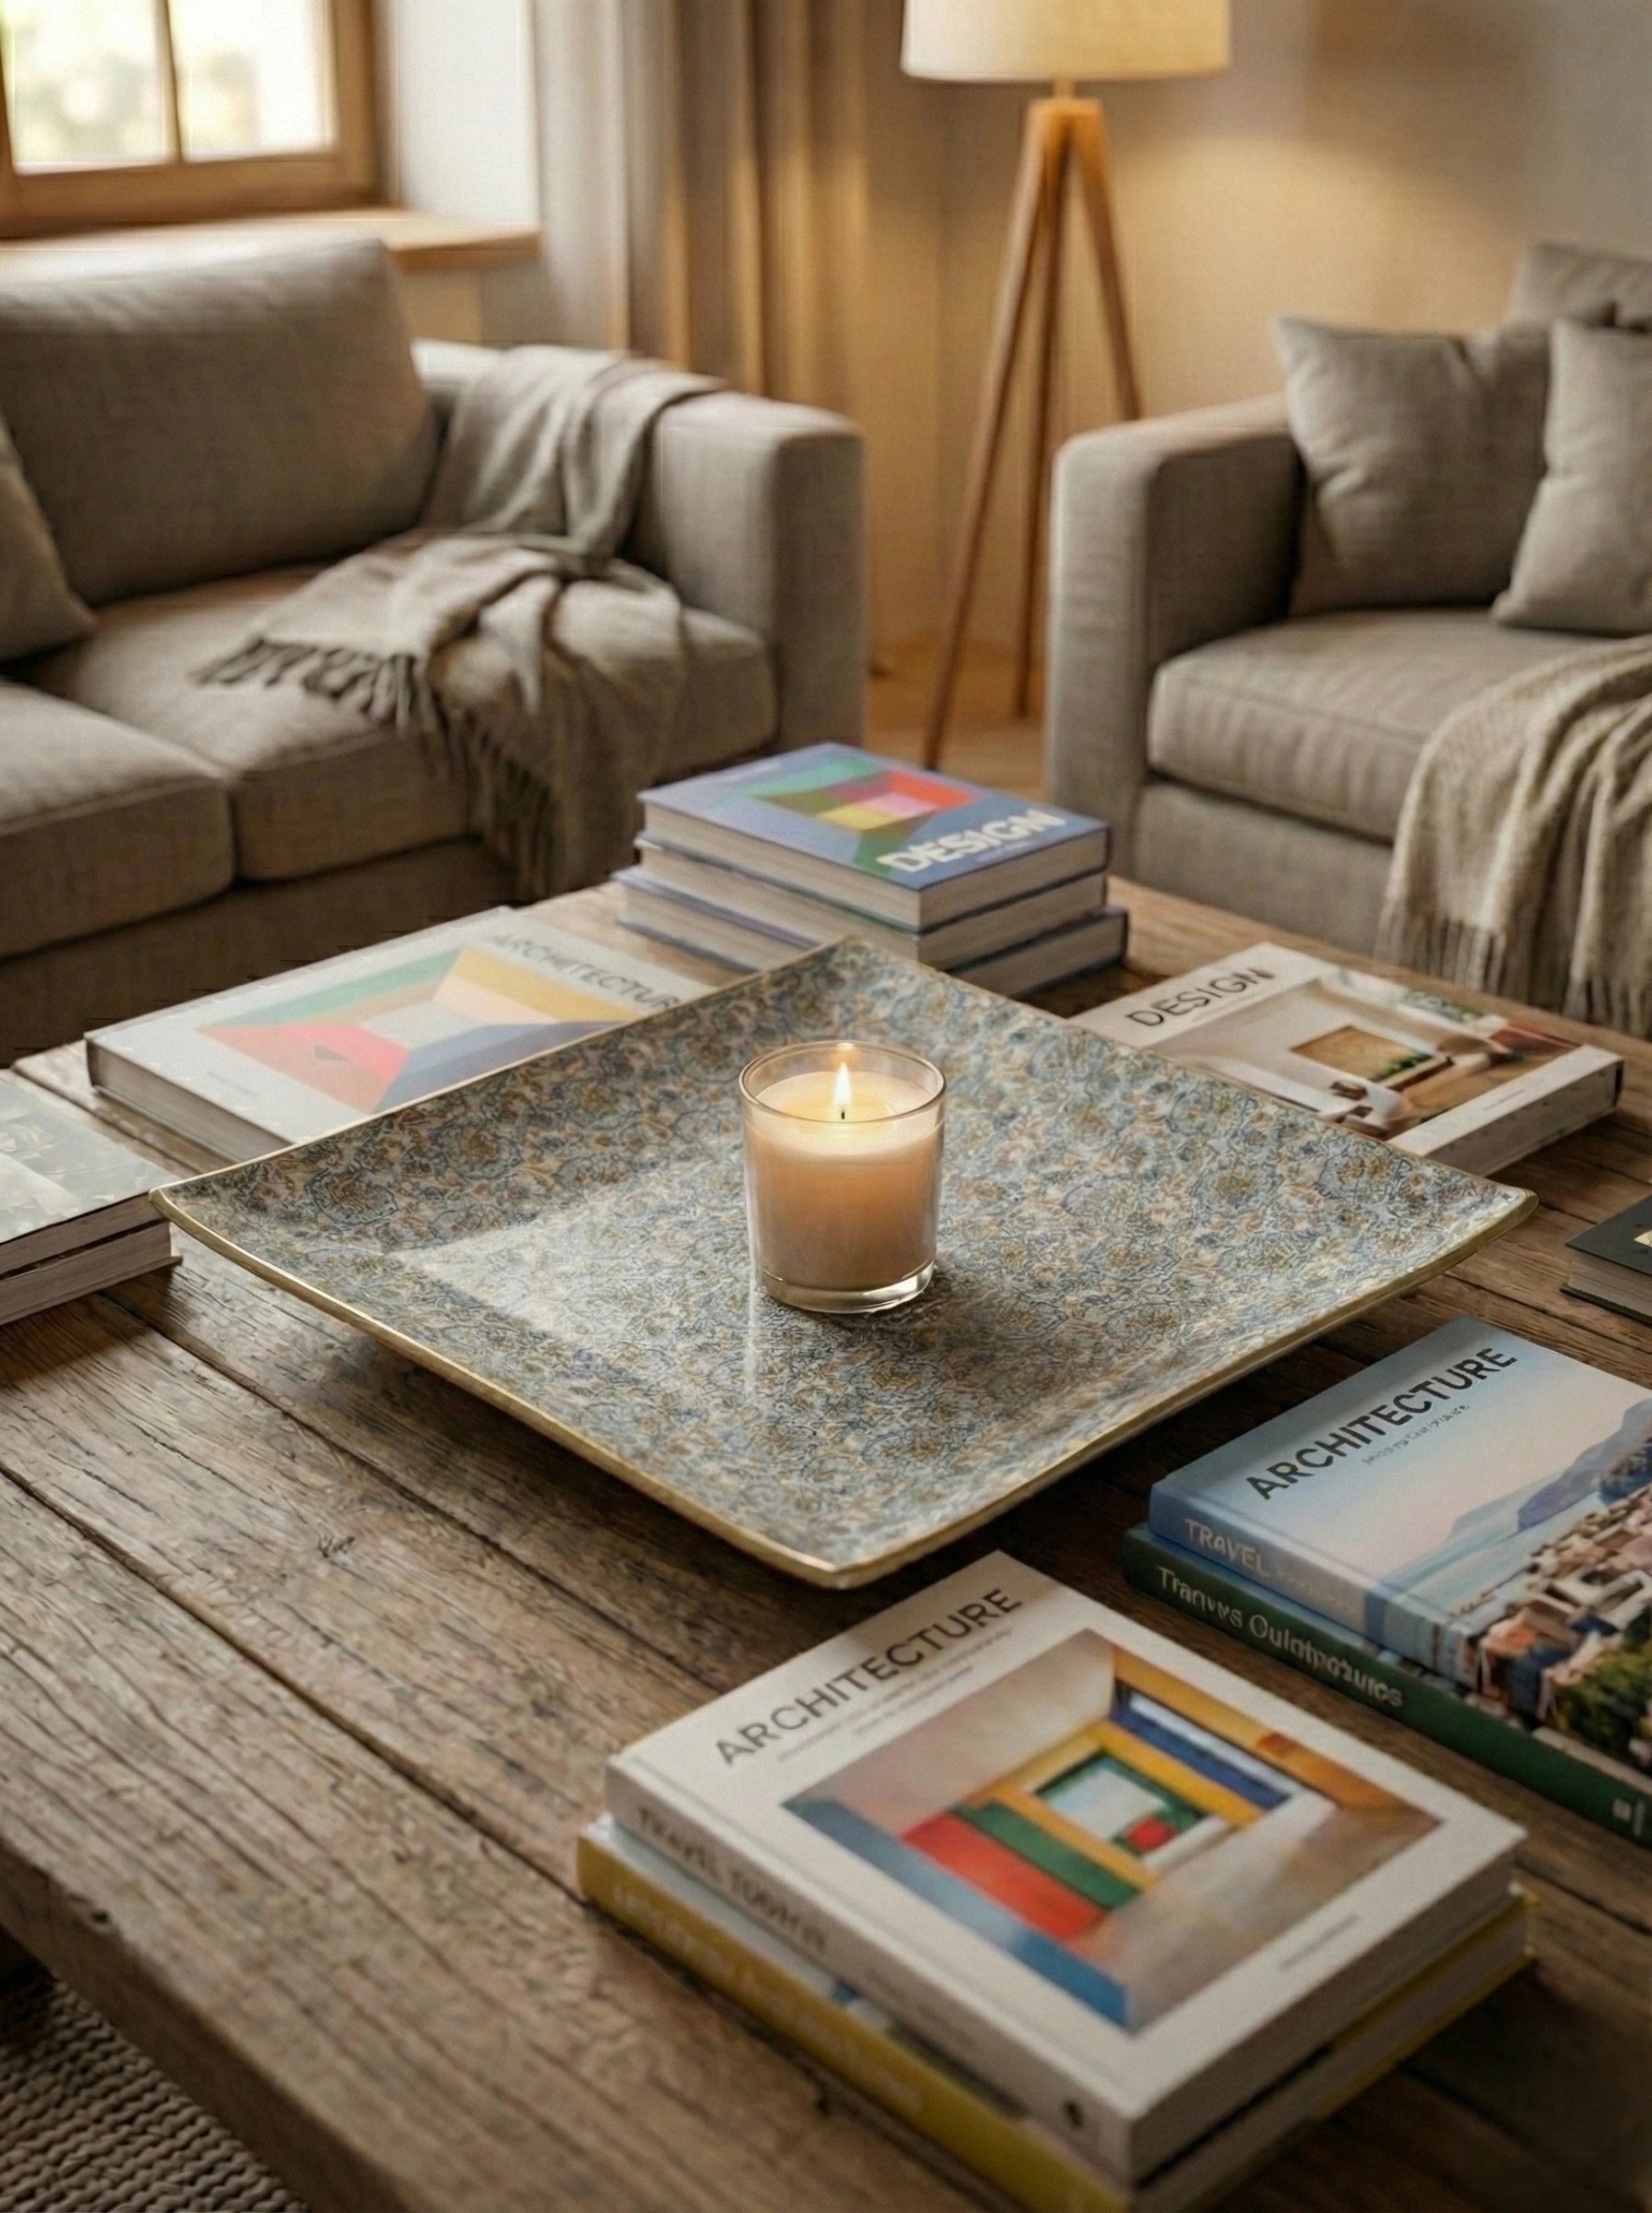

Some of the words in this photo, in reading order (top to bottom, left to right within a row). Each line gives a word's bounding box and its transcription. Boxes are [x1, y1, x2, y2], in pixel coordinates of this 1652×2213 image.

[876, 808, 1067, 872] DESIGN
[489, 933, 683, 1012] ARCHITECTUR
[1126, 968, 1275, 1026] DESIGN
[1245, 1347, 1518, 1500] ARCHITECTURE
[716, 1588, 1023, 1766] ARCHITECTURE
